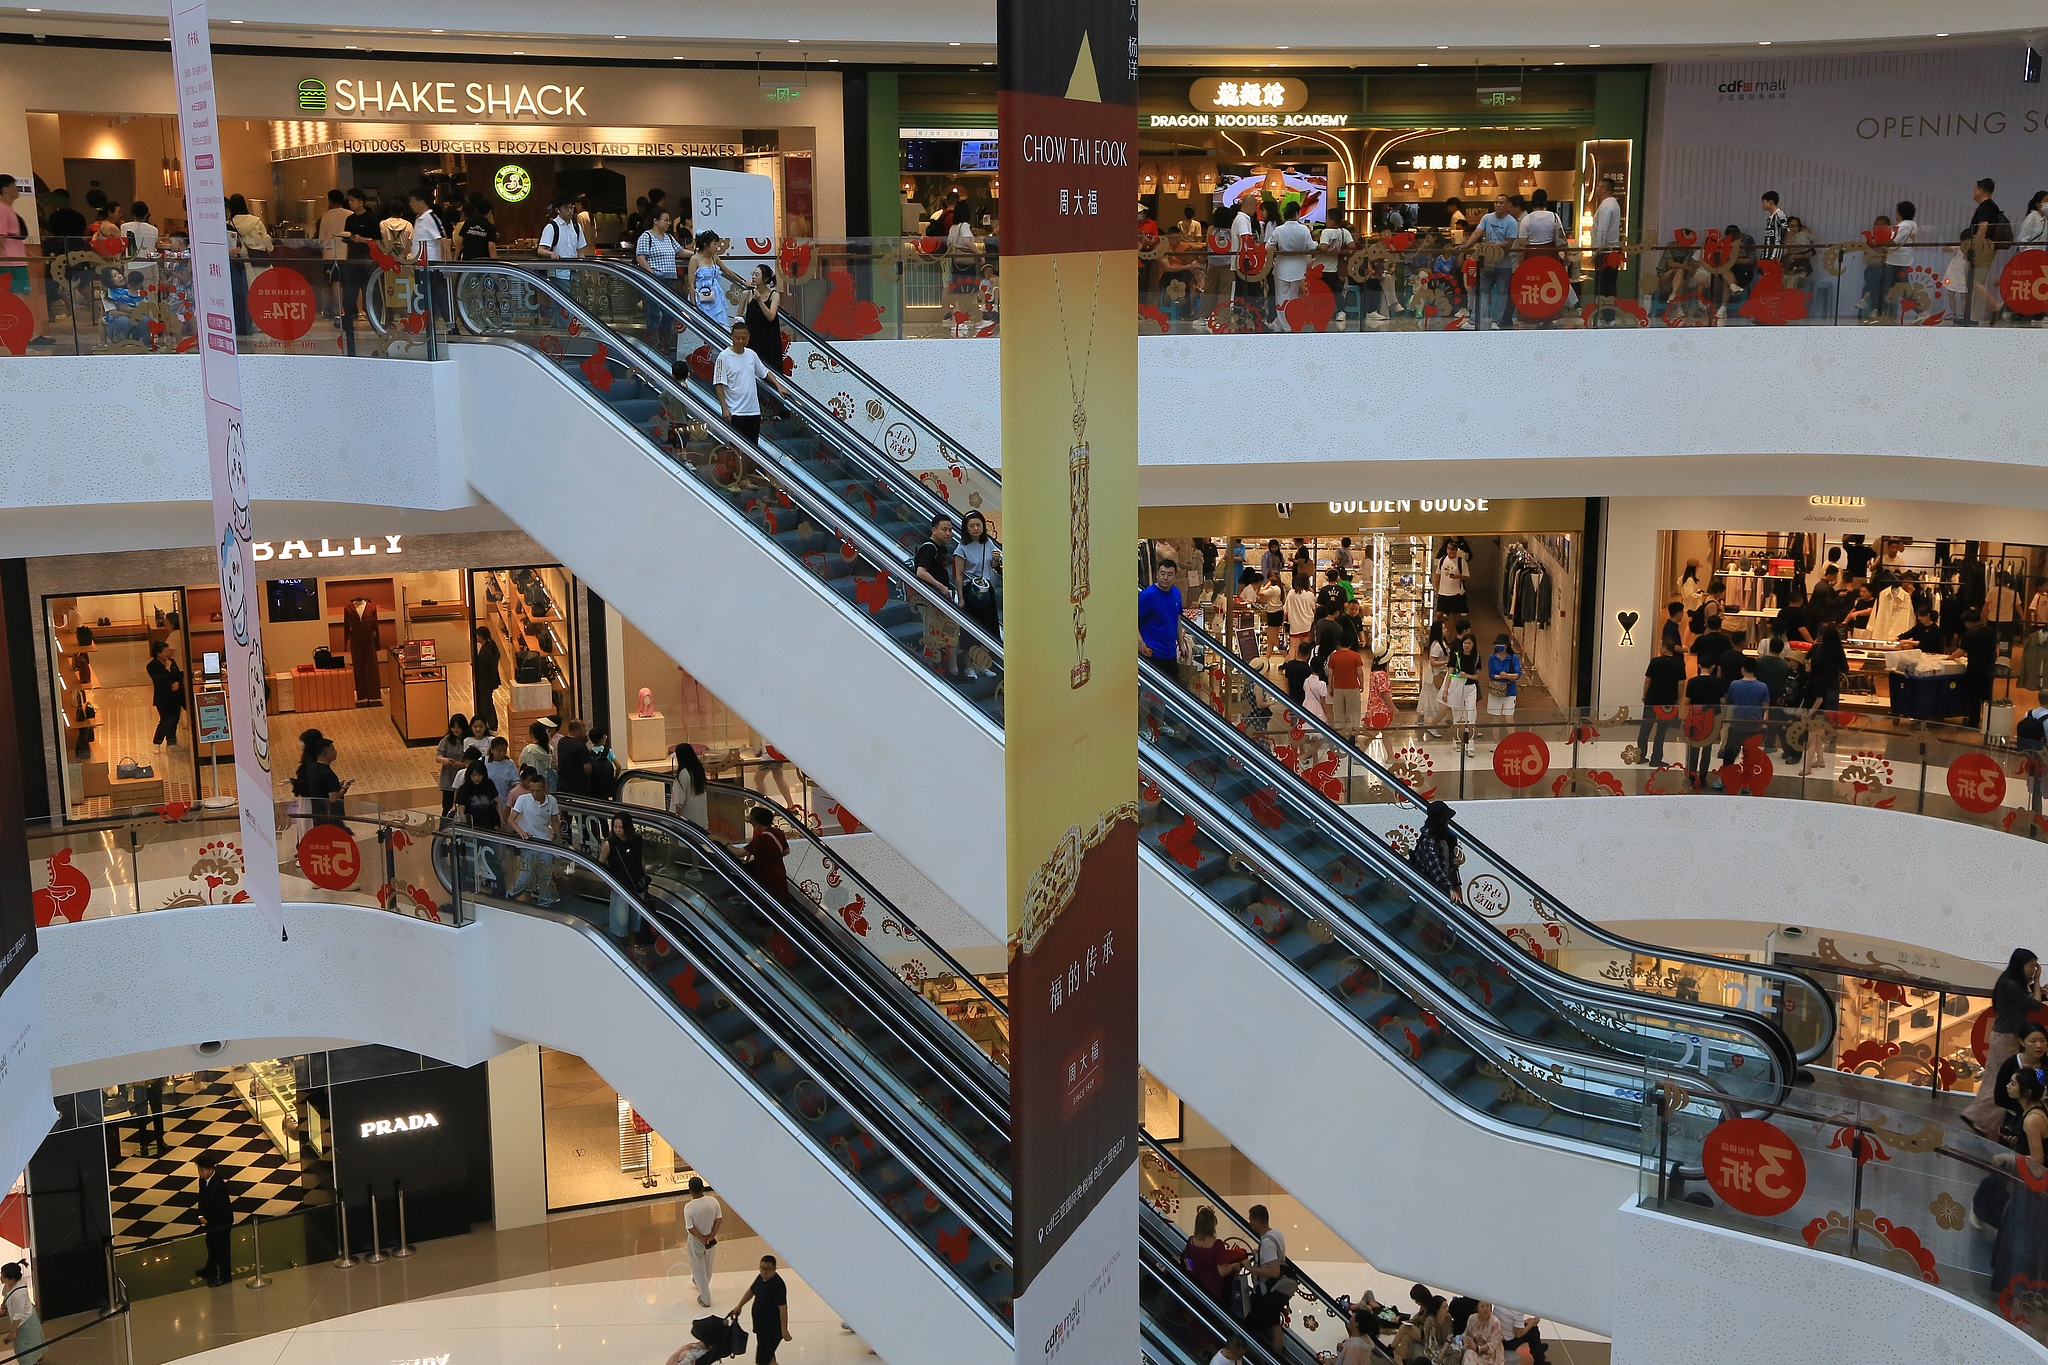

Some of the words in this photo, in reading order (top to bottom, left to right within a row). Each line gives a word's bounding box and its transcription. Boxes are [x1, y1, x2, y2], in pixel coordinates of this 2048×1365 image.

[1127, 35, 1138, 80] 杨洋
[334, 79, 458, 113] SHAKE
[465, 82, 588, 116] SHACK
[1755, 78, 1786, 92] mall
[1150, 114, 1209, 127] DRAGON
[1214, 114, 1278, 127] NOODLES
[1283, 114, 1349, 127] ACADEMY
[1856, 111, 2007, 140] OPENING
[2023, 110, 2048, 133] S
[343, 139, 367, 152] HOT
[371, 139, 406, 152] DOGS
[420, 140, 491, 153] BURGERS
[497, 141, 558, 154] FROZEN
[561, 142, 630, 155] CUSTARD
[636, 143, 675, 156] FRIES
[681, 144, 735, 157] SHAKES
[1023, 133, 1067, 164] CHOW
[1070, 137, 1090, 165] TAI
[1094, 140, 1128, 167] FOOK
[1477, 153, 1542, 170] 走向世界
[700, 189, 713, 197] B区
[1059, 188, 1098, 216] 周大福
[700, 197, 724, 217] 3F
[1329, 499, 1411, 514] GOLDEN
[1420, 498, 1489, 513] GOOSE
[1803, 514, 1837, 522] alexandre
[1838, 516, 1870, 524] mattiussi
[252, 534, 403, 562] BALLY
[1049, 930, 1115, 1014] 福的传承
[1068, 1040, 1099, 1086] 周大福
[1668, 1033, 1728, 1077] 2F
[1071, 1087, 1085, 1106] SINCE
[360, 1112, 440, 1139] PRADA
[1045, 1324, 1059, 1354] cdf
[1063, 1297, 1080, 1331] mall
